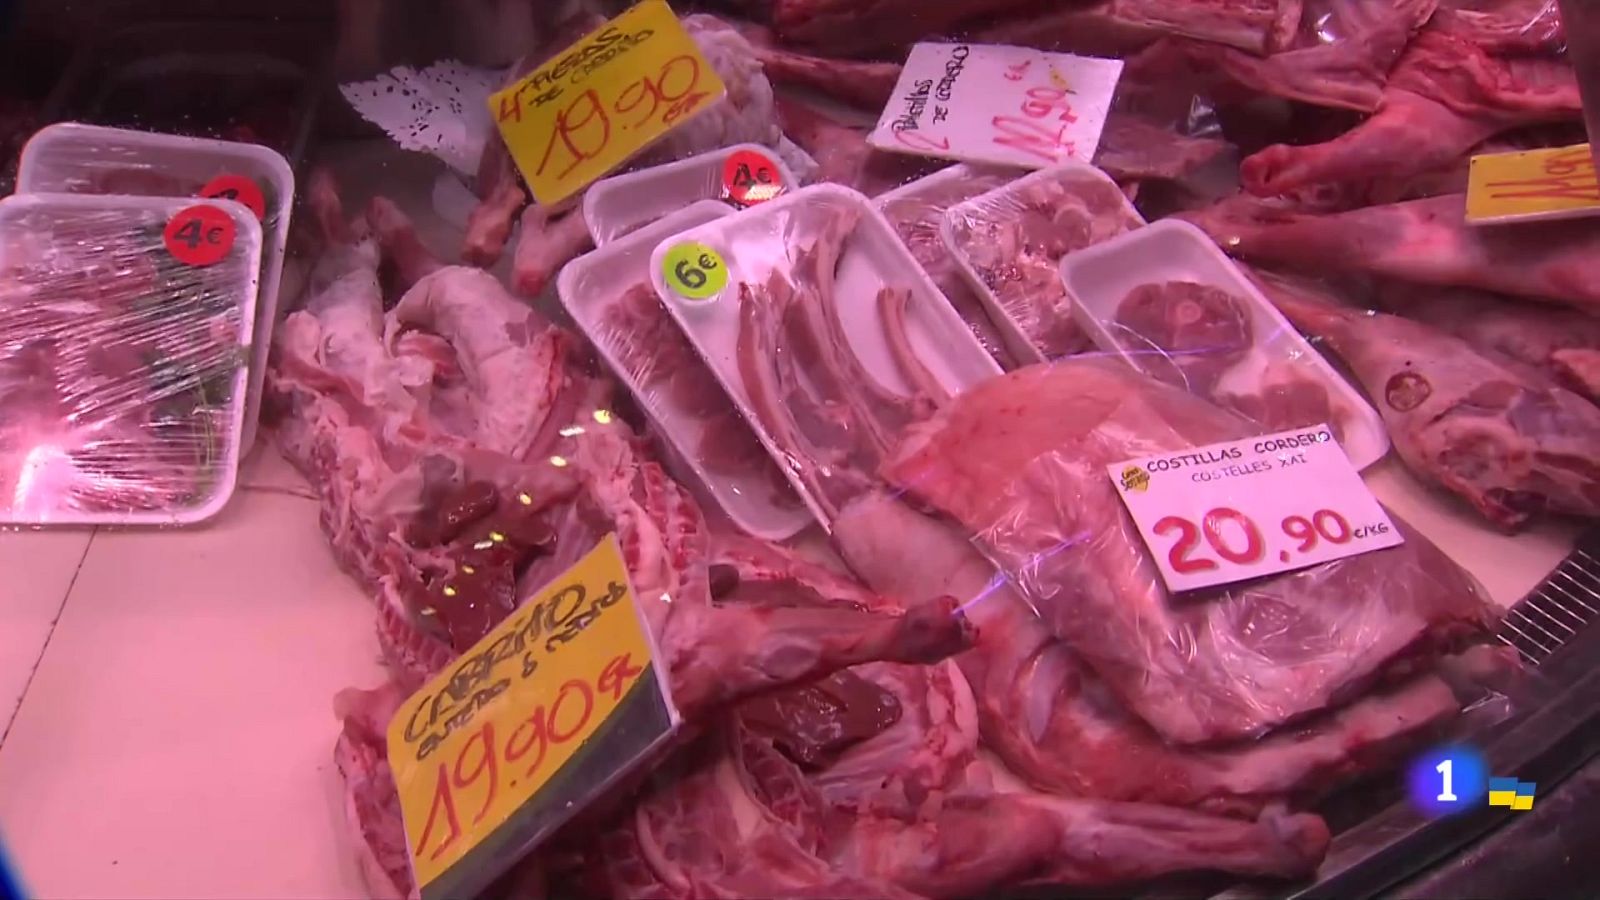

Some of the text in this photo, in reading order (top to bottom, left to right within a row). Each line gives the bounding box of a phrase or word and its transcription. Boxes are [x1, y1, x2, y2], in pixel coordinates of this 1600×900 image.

[528, 87, 564, 108] DE
[173, 219, 224, 249] 4€
[675, 254, 717, 289] 6€
[1146, 430, 1331, 473] COSTILLAS CORDERO
[1191, 453, 1308, 483] COSTELLES XAI
[404, 583, 586, 743] CABRITO
[416, 678, 595, 861] 19.90
